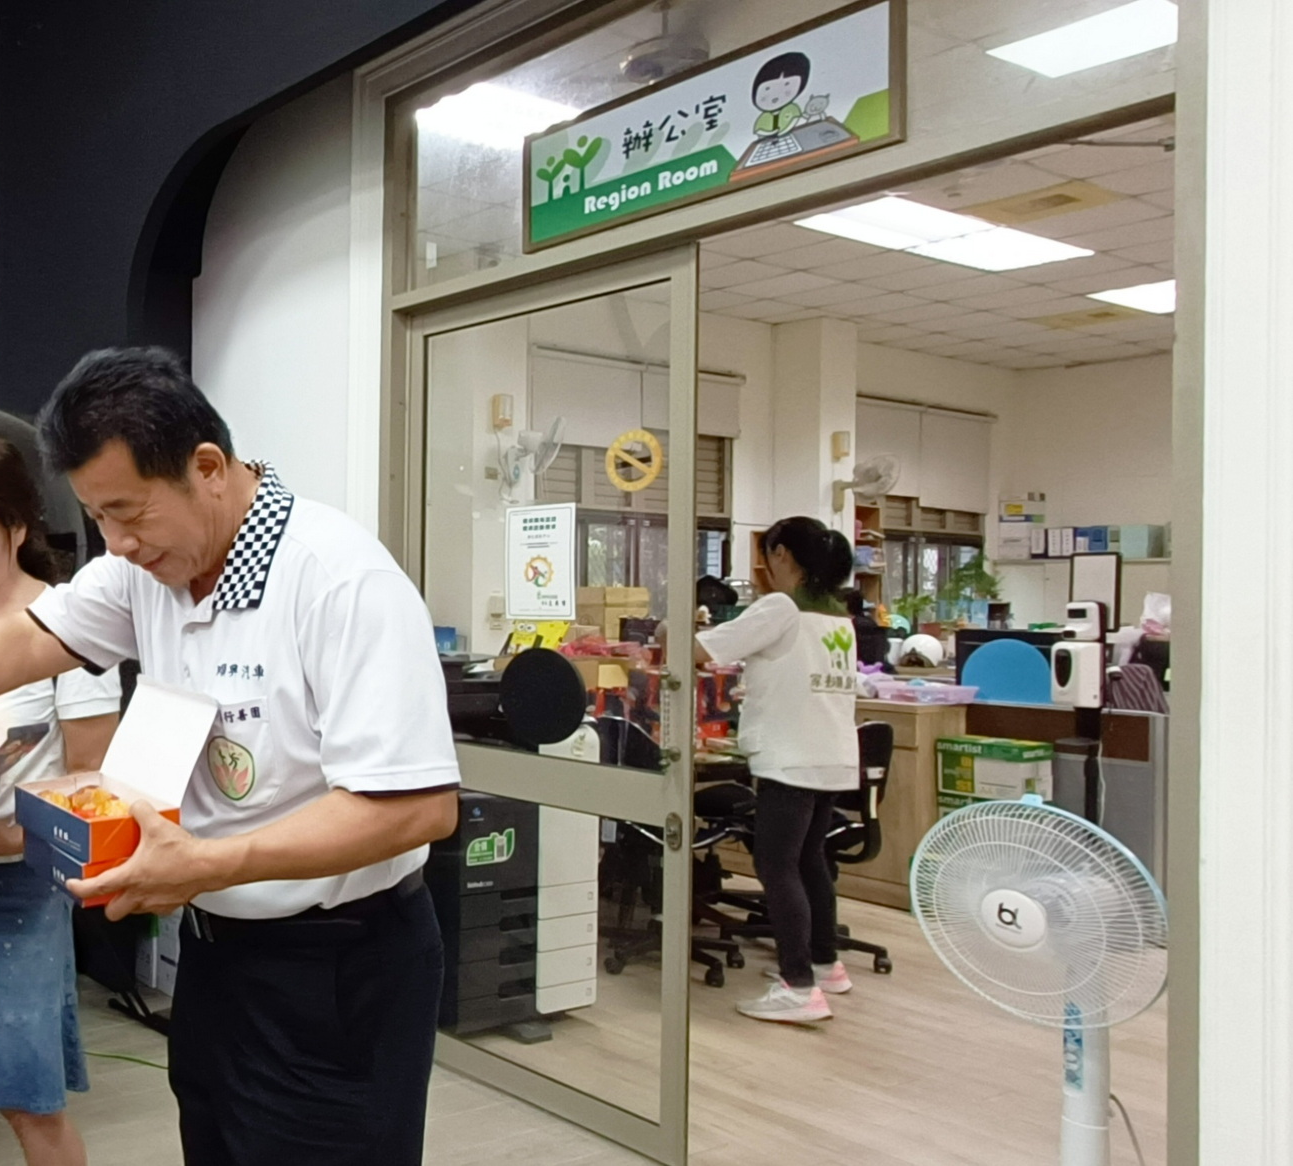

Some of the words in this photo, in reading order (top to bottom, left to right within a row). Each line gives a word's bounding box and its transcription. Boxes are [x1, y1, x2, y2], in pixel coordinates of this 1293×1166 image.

[622, 94, 727, 160] 辦公室
[584, 181, 652, 215] Region
[658, 159, 719, 192] Room
